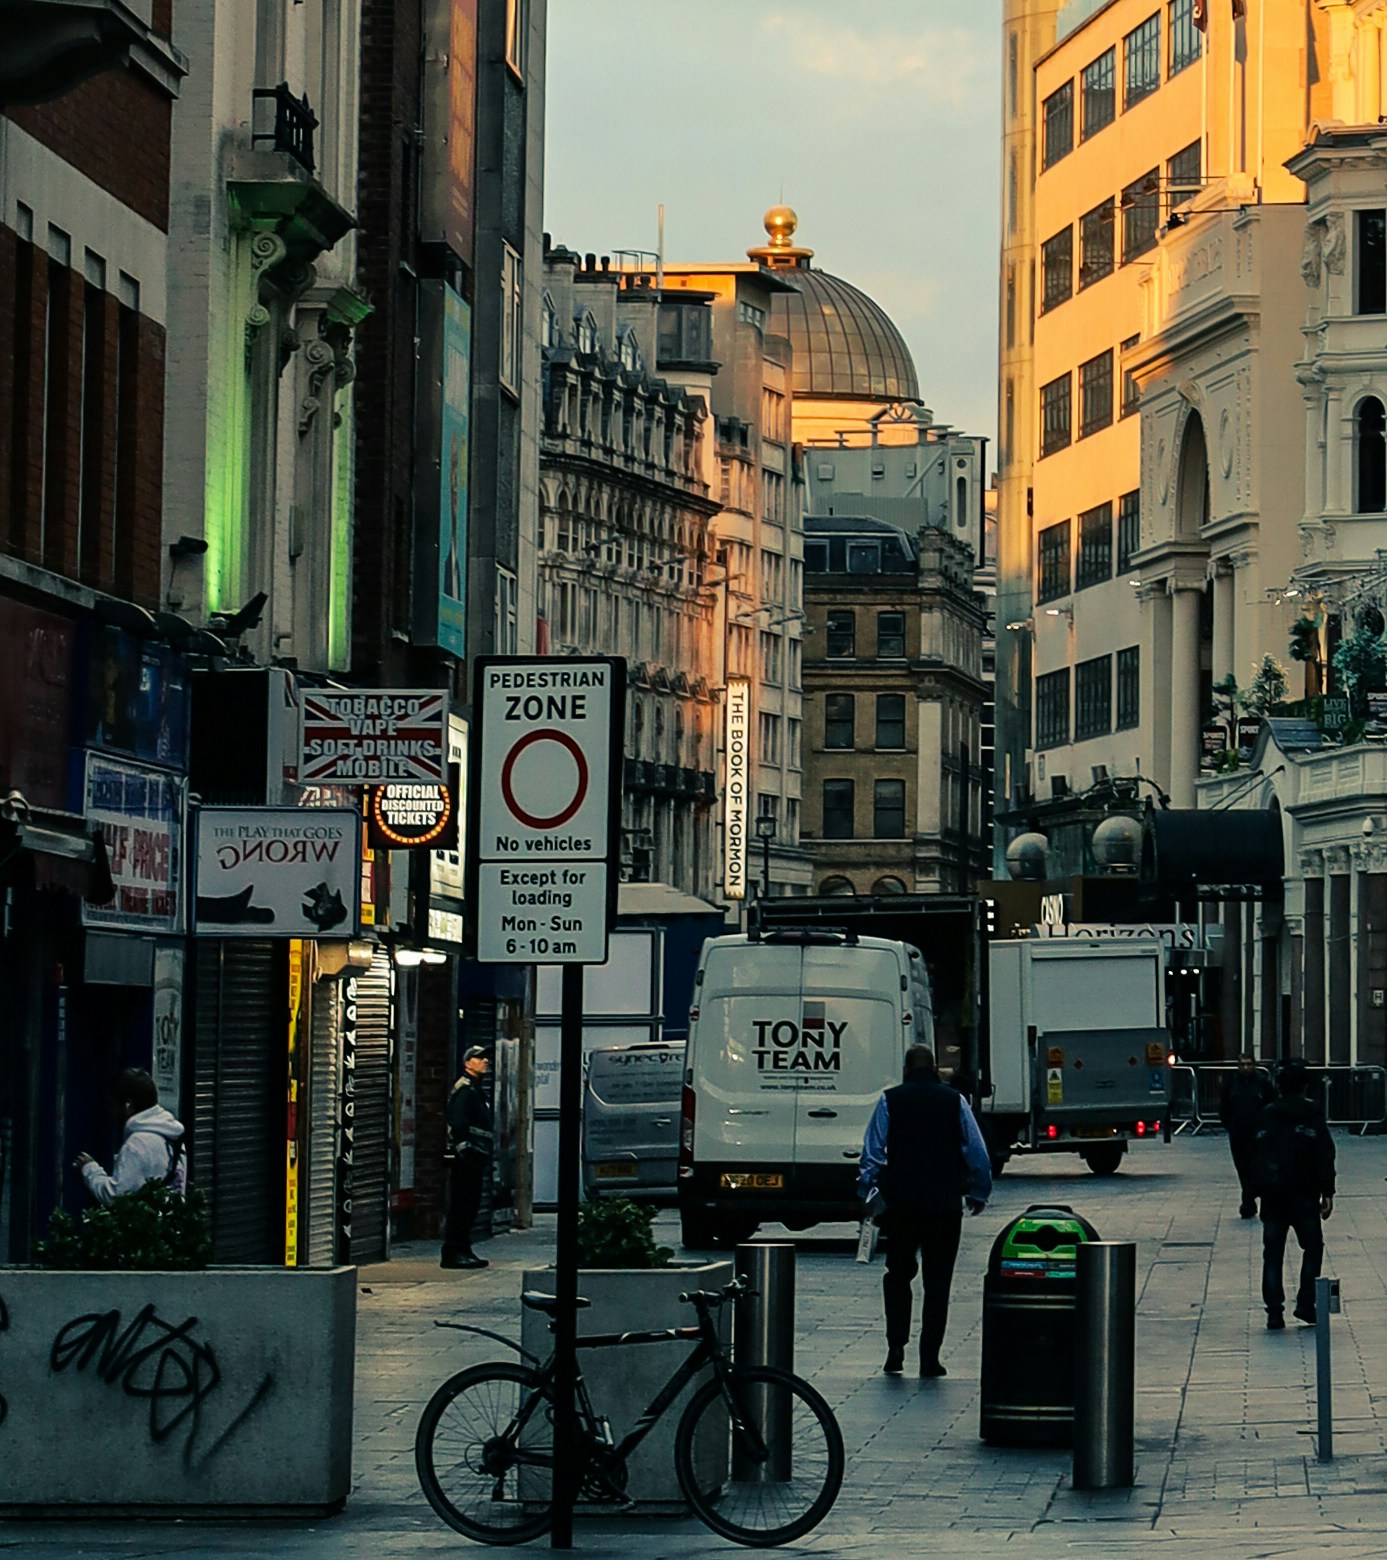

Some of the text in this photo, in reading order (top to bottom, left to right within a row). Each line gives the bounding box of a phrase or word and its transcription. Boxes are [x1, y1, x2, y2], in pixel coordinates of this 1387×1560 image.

[490, 671, 605, 689] PEDESTRIAN
[329, 698, 420, 715] TOBACCO
[504, 695, 587, 720] ZONE
[349, 719, 398, 736] VAPE
[310, 739, 358, 755] SOFT
[362, 739, 436, 756] DRINKS
[336, 760, 409, 776] MOBILE
[386, 784, 440, 799] OFFICIAL
[729, 692, 744, 886] THE BOOK OF MORMON
[381, 799, 444, 811] DISCOUNTED
[387, 812, 437, 825] TICKETS
[213, 825, 343, 840] THE PLAY THAT GOES
[496, 836, 592, 852] No vehicles
[500, 869, 586, 888] Except for
[512, 890, 572, 907] loading
[502, 916, 536, 931] Mon
[550, 915, 582, 931] Sun
[552, 941, 577, 954] am
[752, 1020, 848, 1048] TONY
[752, 1050, 841, 1070] TEAM
